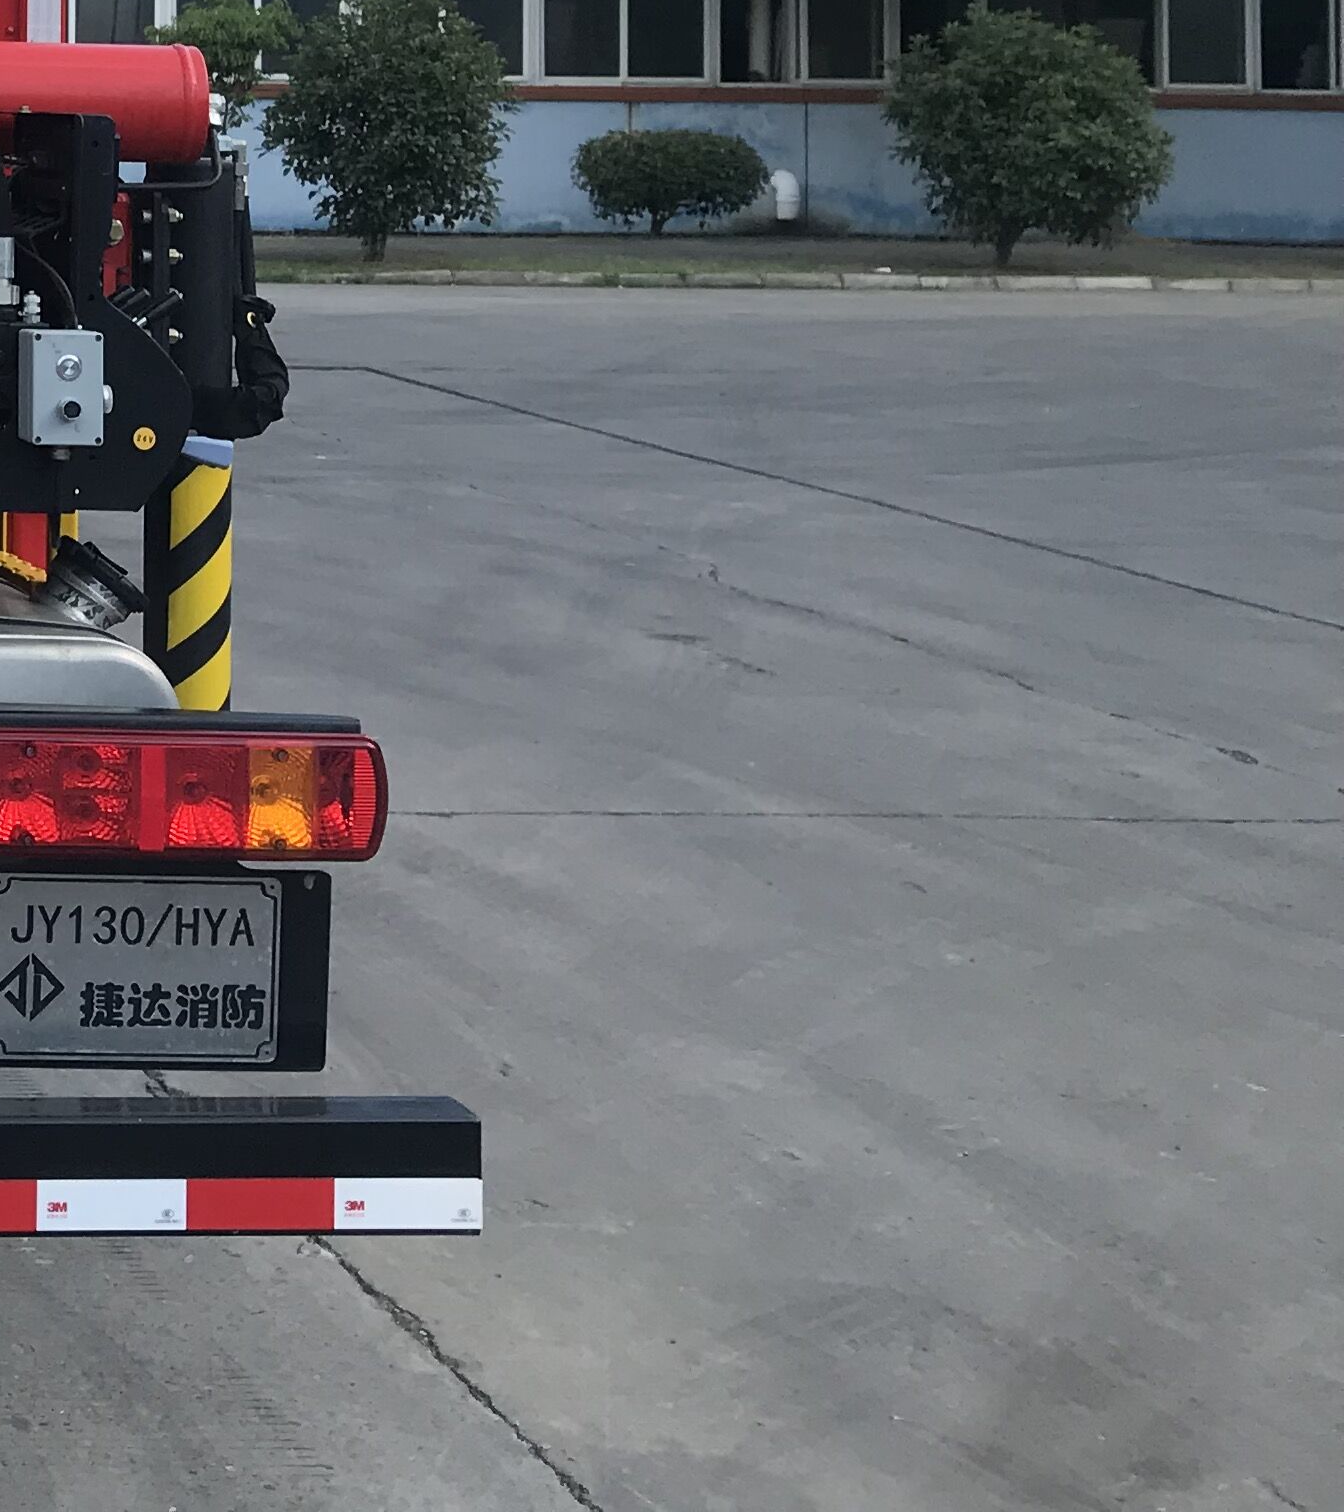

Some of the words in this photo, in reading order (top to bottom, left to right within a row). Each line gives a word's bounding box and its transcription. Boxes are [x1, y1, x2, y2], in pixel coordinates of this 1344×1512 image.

[10, 903, 255, 948] JY130/HYA
[78, 981, 267, 1030] 捷达消防
[47, 1201, 67, 1213] 3M
[344, 1200, 365, 1211] 3M
